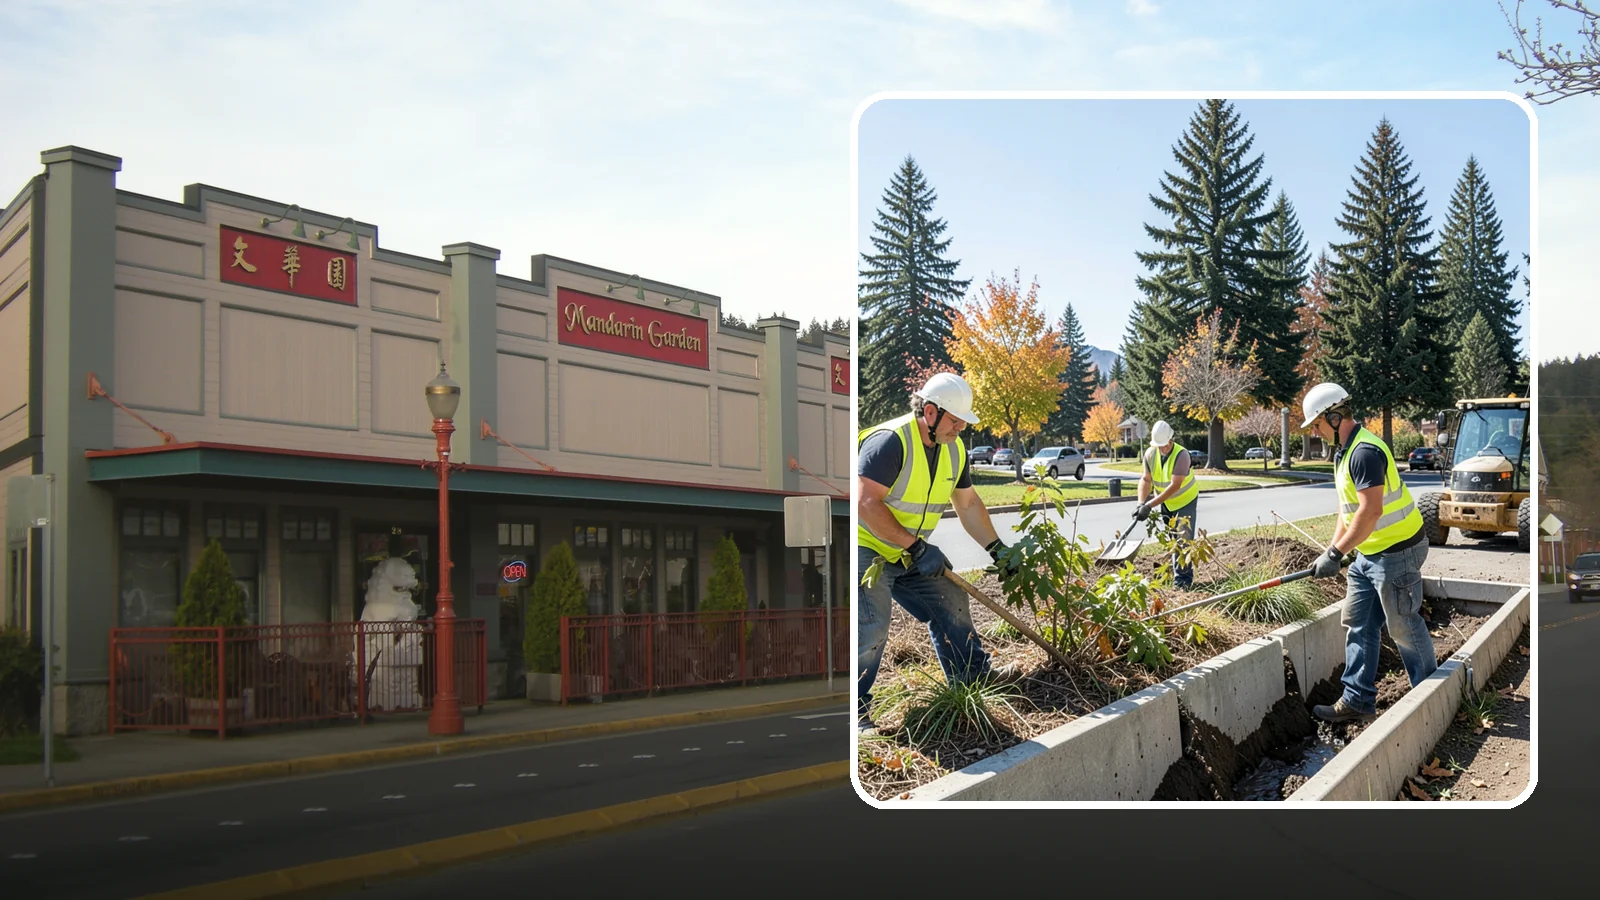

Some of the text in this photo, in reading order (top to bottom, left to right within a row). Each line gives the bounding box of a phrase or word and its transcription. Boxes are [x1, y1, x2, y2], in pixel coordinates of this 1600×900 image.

[231, 236, 346, 290] 文華園
[564, 302, 701, 352] Mandarin Garden
[503, 565, 527, 578] OPEN
